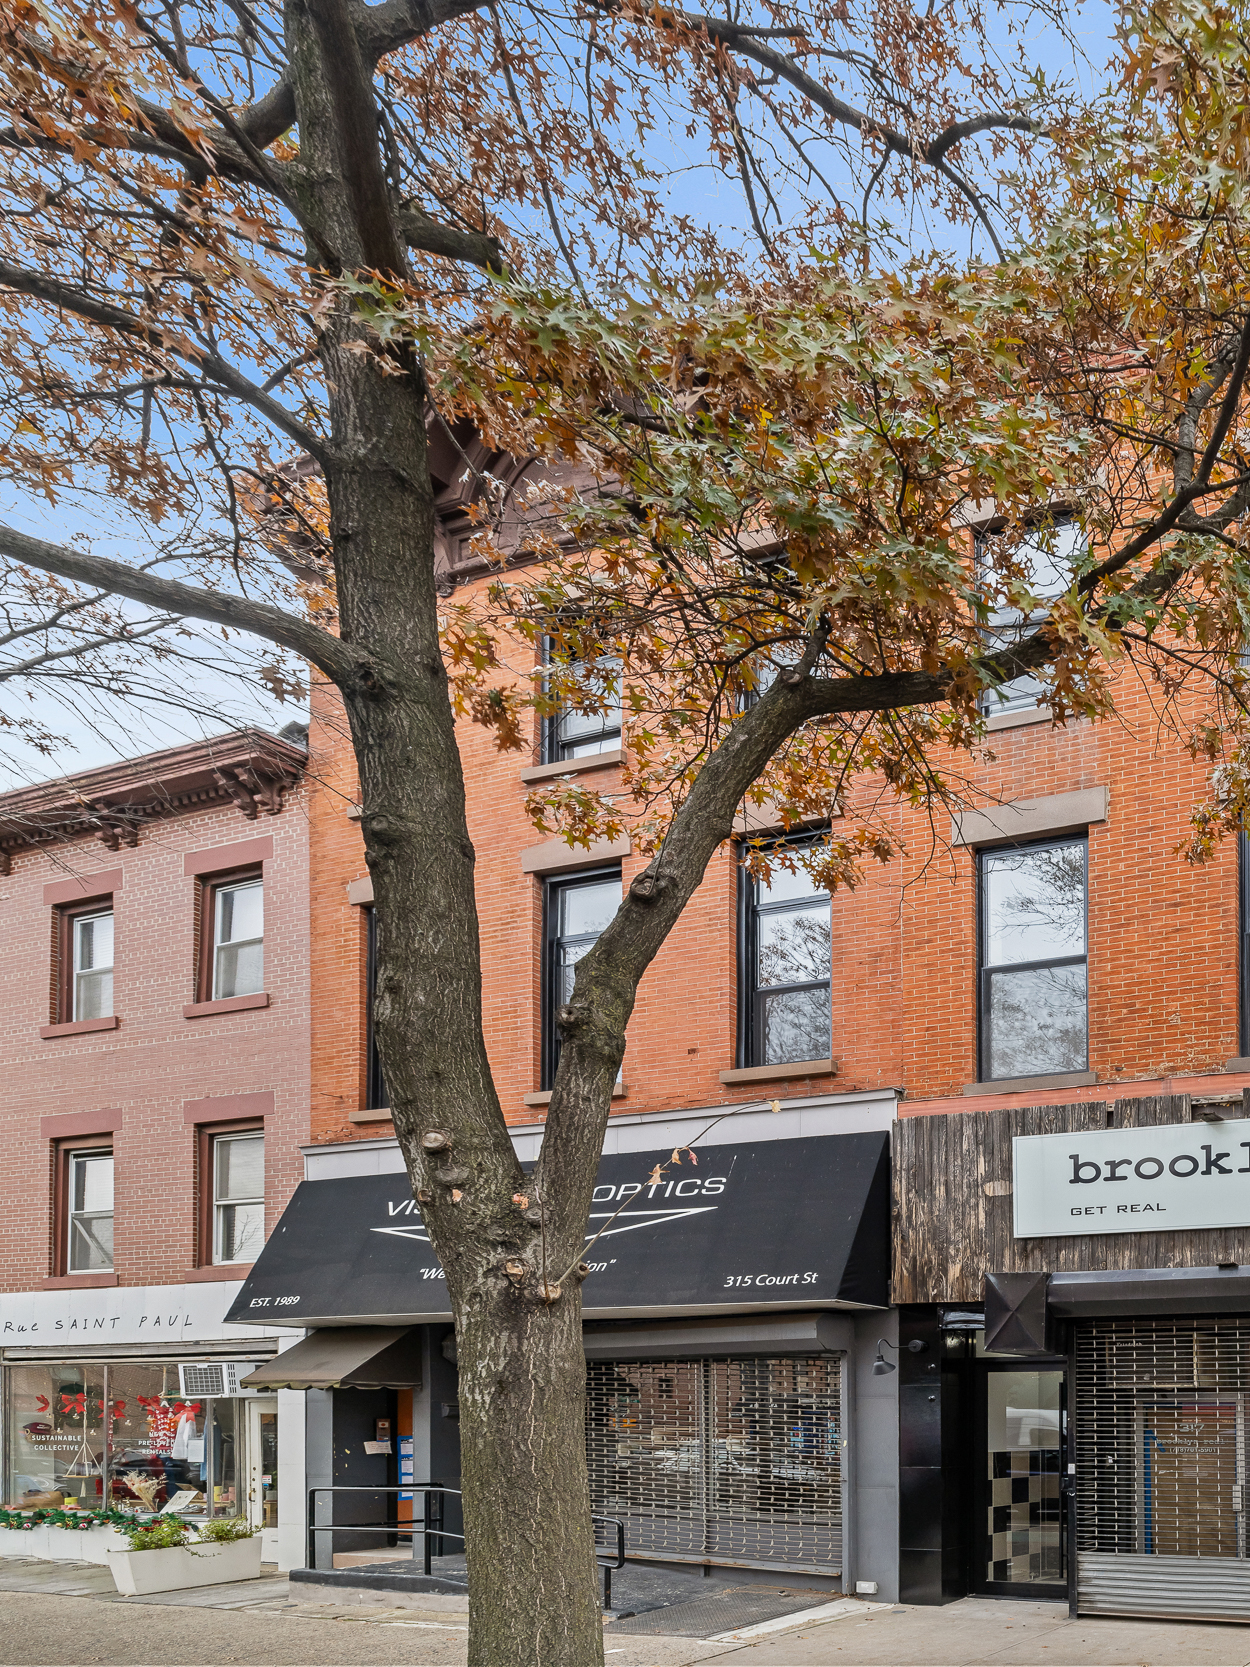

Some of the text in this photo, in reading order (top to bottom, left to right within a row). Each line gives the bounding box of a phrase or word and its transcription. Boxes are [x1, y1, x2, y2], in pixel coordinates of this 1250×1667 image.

[592, 1177, 727, 1202] OPTICS
[1070, 1203, 1167, 1216] GET REAL
[723, 1272, 819, 1288] 315 Court St
[249, 1295, 301, 1308] EST. 1989
[3, 1315, 193, 1333] Rue SAINT PAUL
[1179, 1423, 1205, 1432] 317
